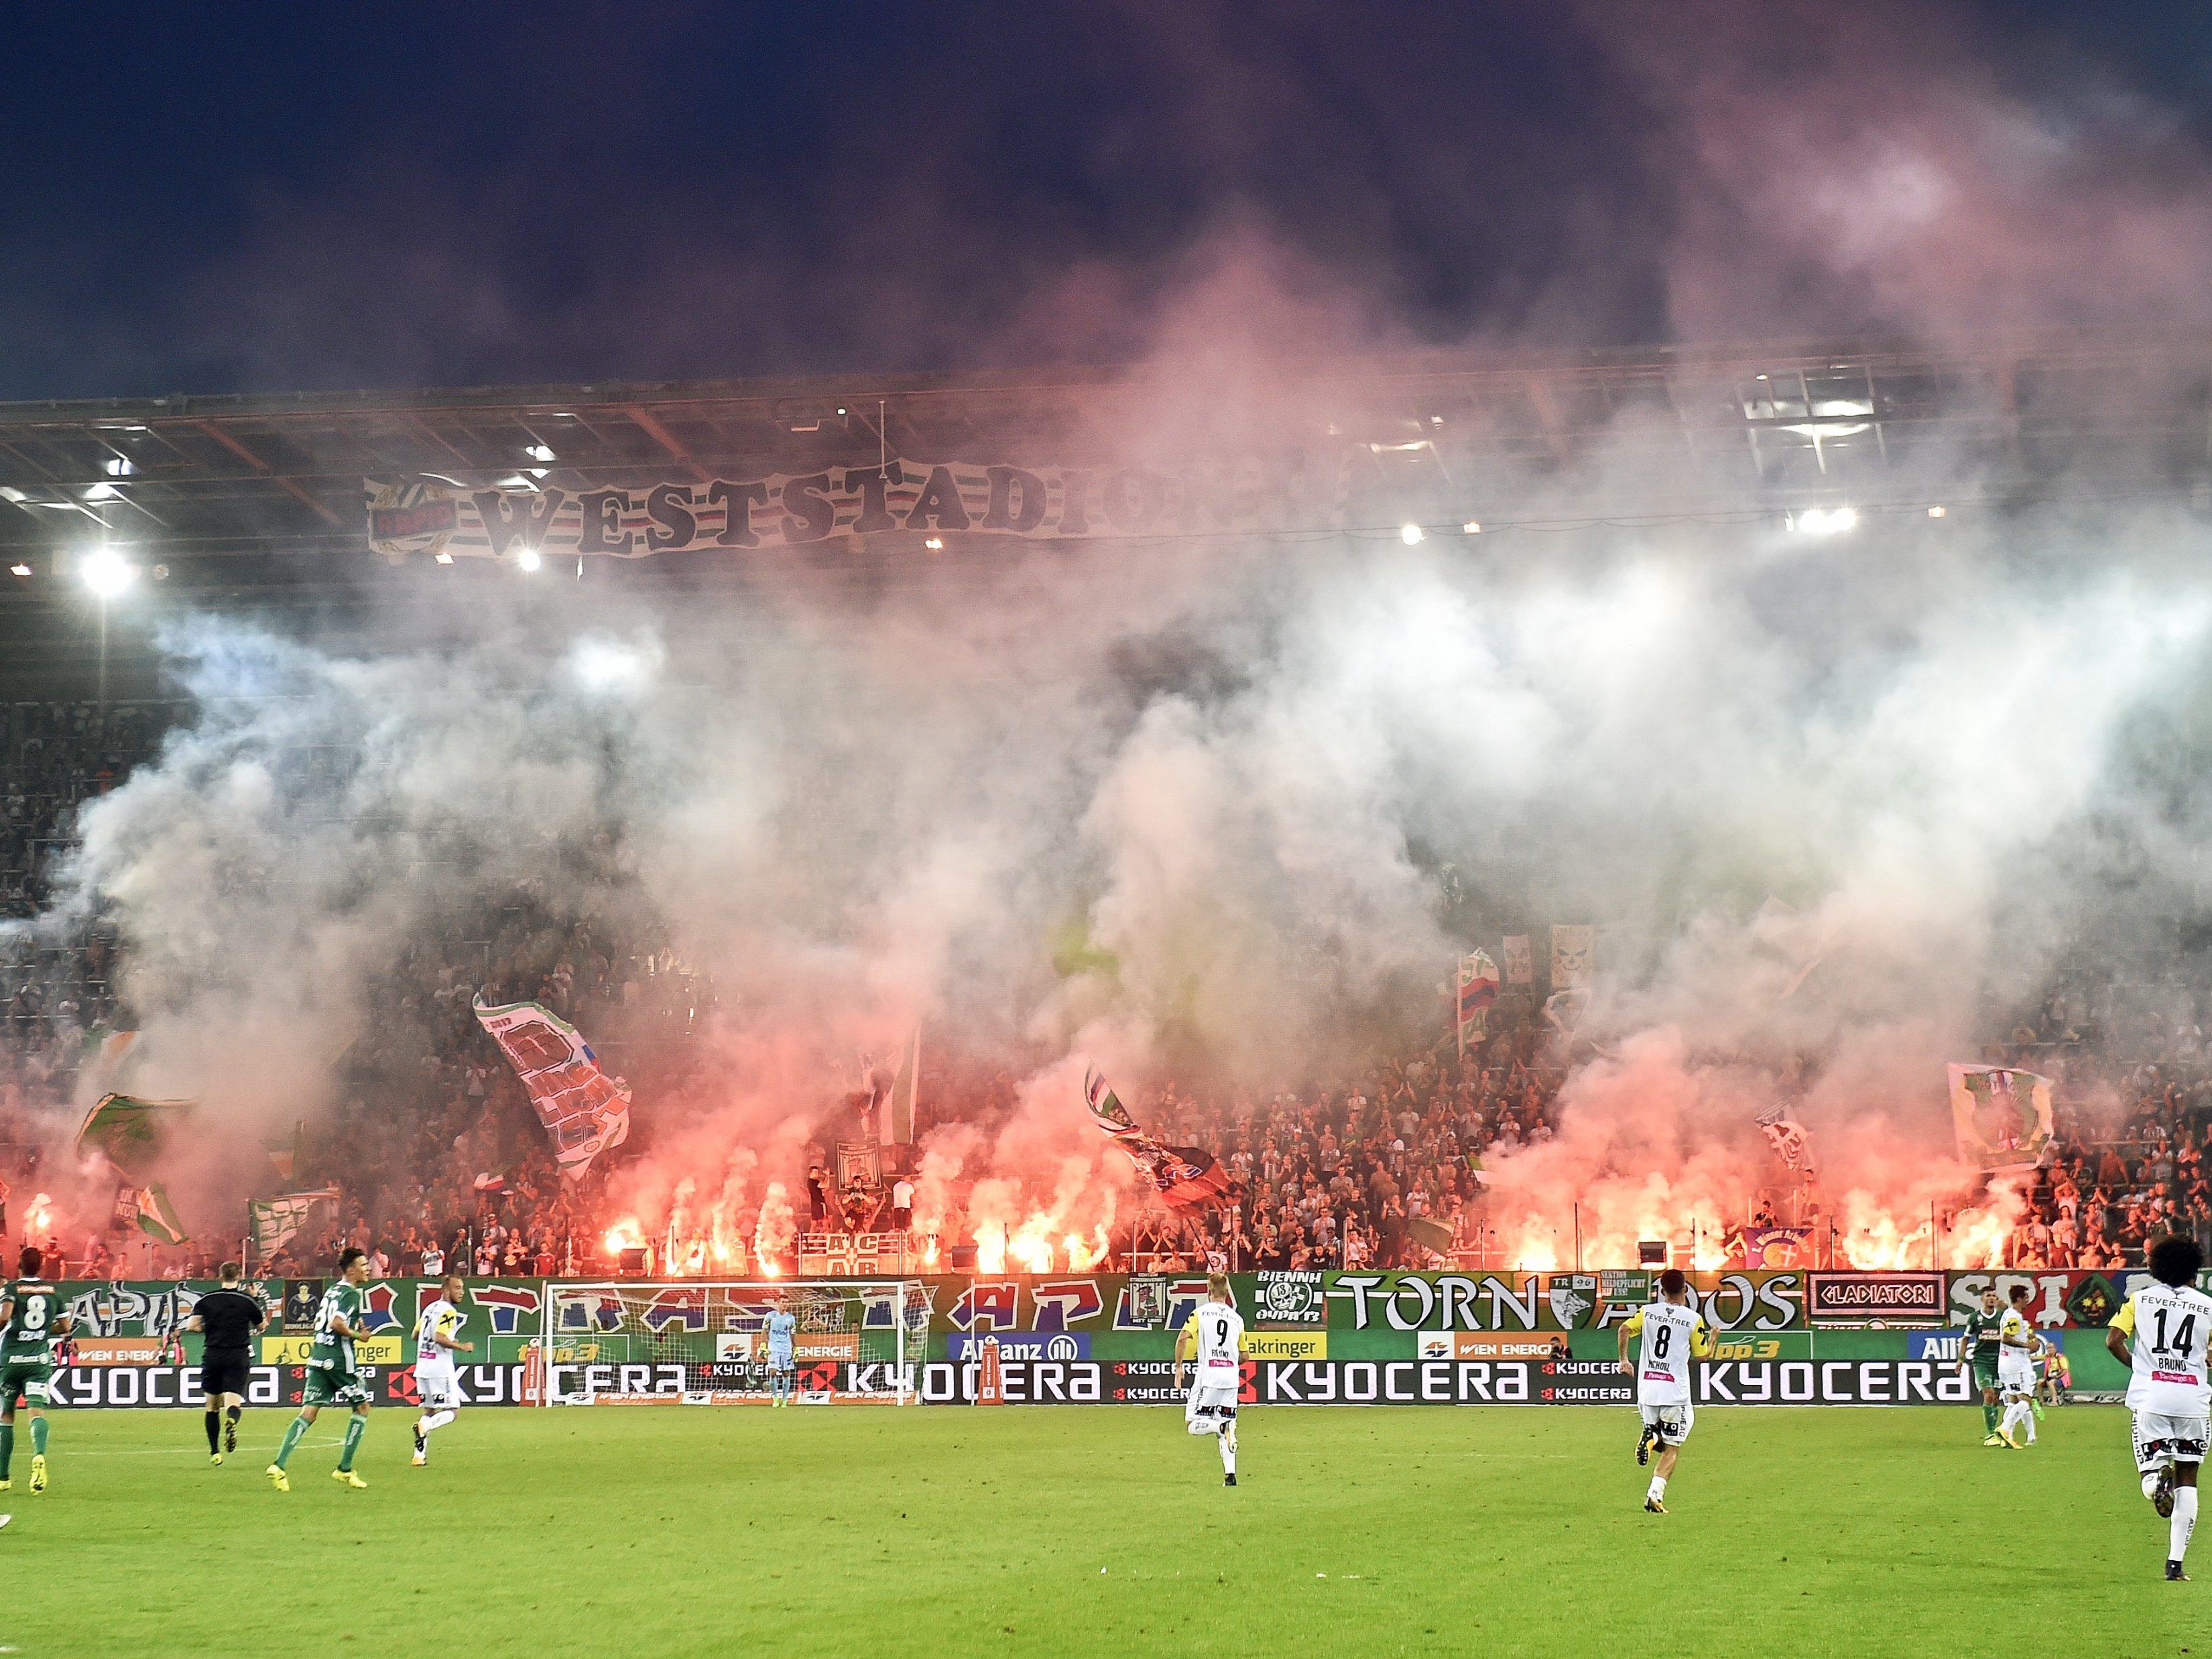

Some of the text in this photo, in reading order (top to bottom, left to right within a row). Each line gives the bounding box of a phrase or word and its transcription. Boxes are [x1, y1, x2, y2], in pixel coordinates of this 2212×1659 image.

[1277, 1284, 1286, 1296] 13
[1553, 1278, 1569, 1286] TR
[1821, 1284, 1934, 1304] GLADIATORI
[24, 1295, 46, 1330] 8
[2141, 1296, 2210, 1315] FEVER-TREE
[1645, 1312, 1691, 1327] FEVER-TREE
[1217, 1319, 1228, 1347] 9
[1654, 1325, 1671, 1359] 8
[2151, 1308, 2195, 1359] 14
[78, 1350, 112, 1361] WIEN
[960, 1339, 1042, 1360] Alanz
[1460, 1345, 1552, 1355] WIEN ENERGI
[1556, 1363, 1620, 1374] KYOCER
[2158, 1357, 2187, 1371] BRUNO
[49, 1367, 279, 1404] KYOCEA
[1268, 1362, 1528, 1400] KYOCERA
[1700, 1362, 1969, 1401] KYOCERA
[1127, 1388, 1189, 1399] KYOCER
[1555, 1388, 1631, 1399] KYOCERA
